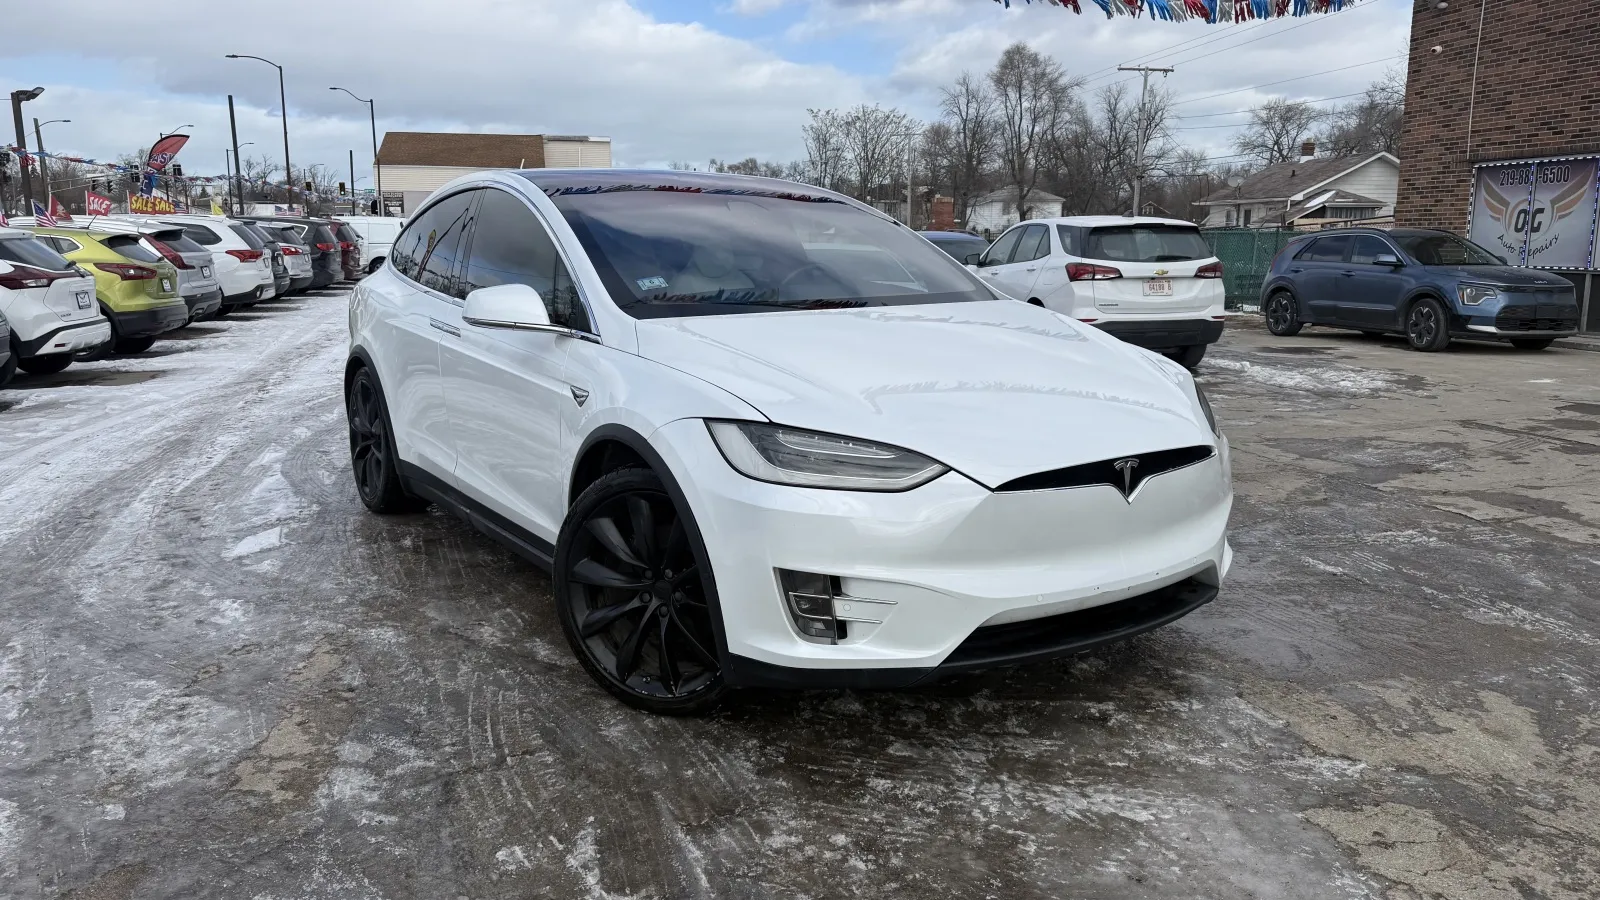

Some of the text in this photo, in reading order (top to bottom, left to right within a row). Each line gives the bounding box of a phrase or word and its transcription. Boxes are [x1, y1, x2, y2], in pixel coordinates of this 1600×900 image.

[89, 196, 111, 214] SALE
[131, 195, 153, 212] SALE
[155, 197, 175, 212] SALE
[1497, 233, 1517, 254] Auto
